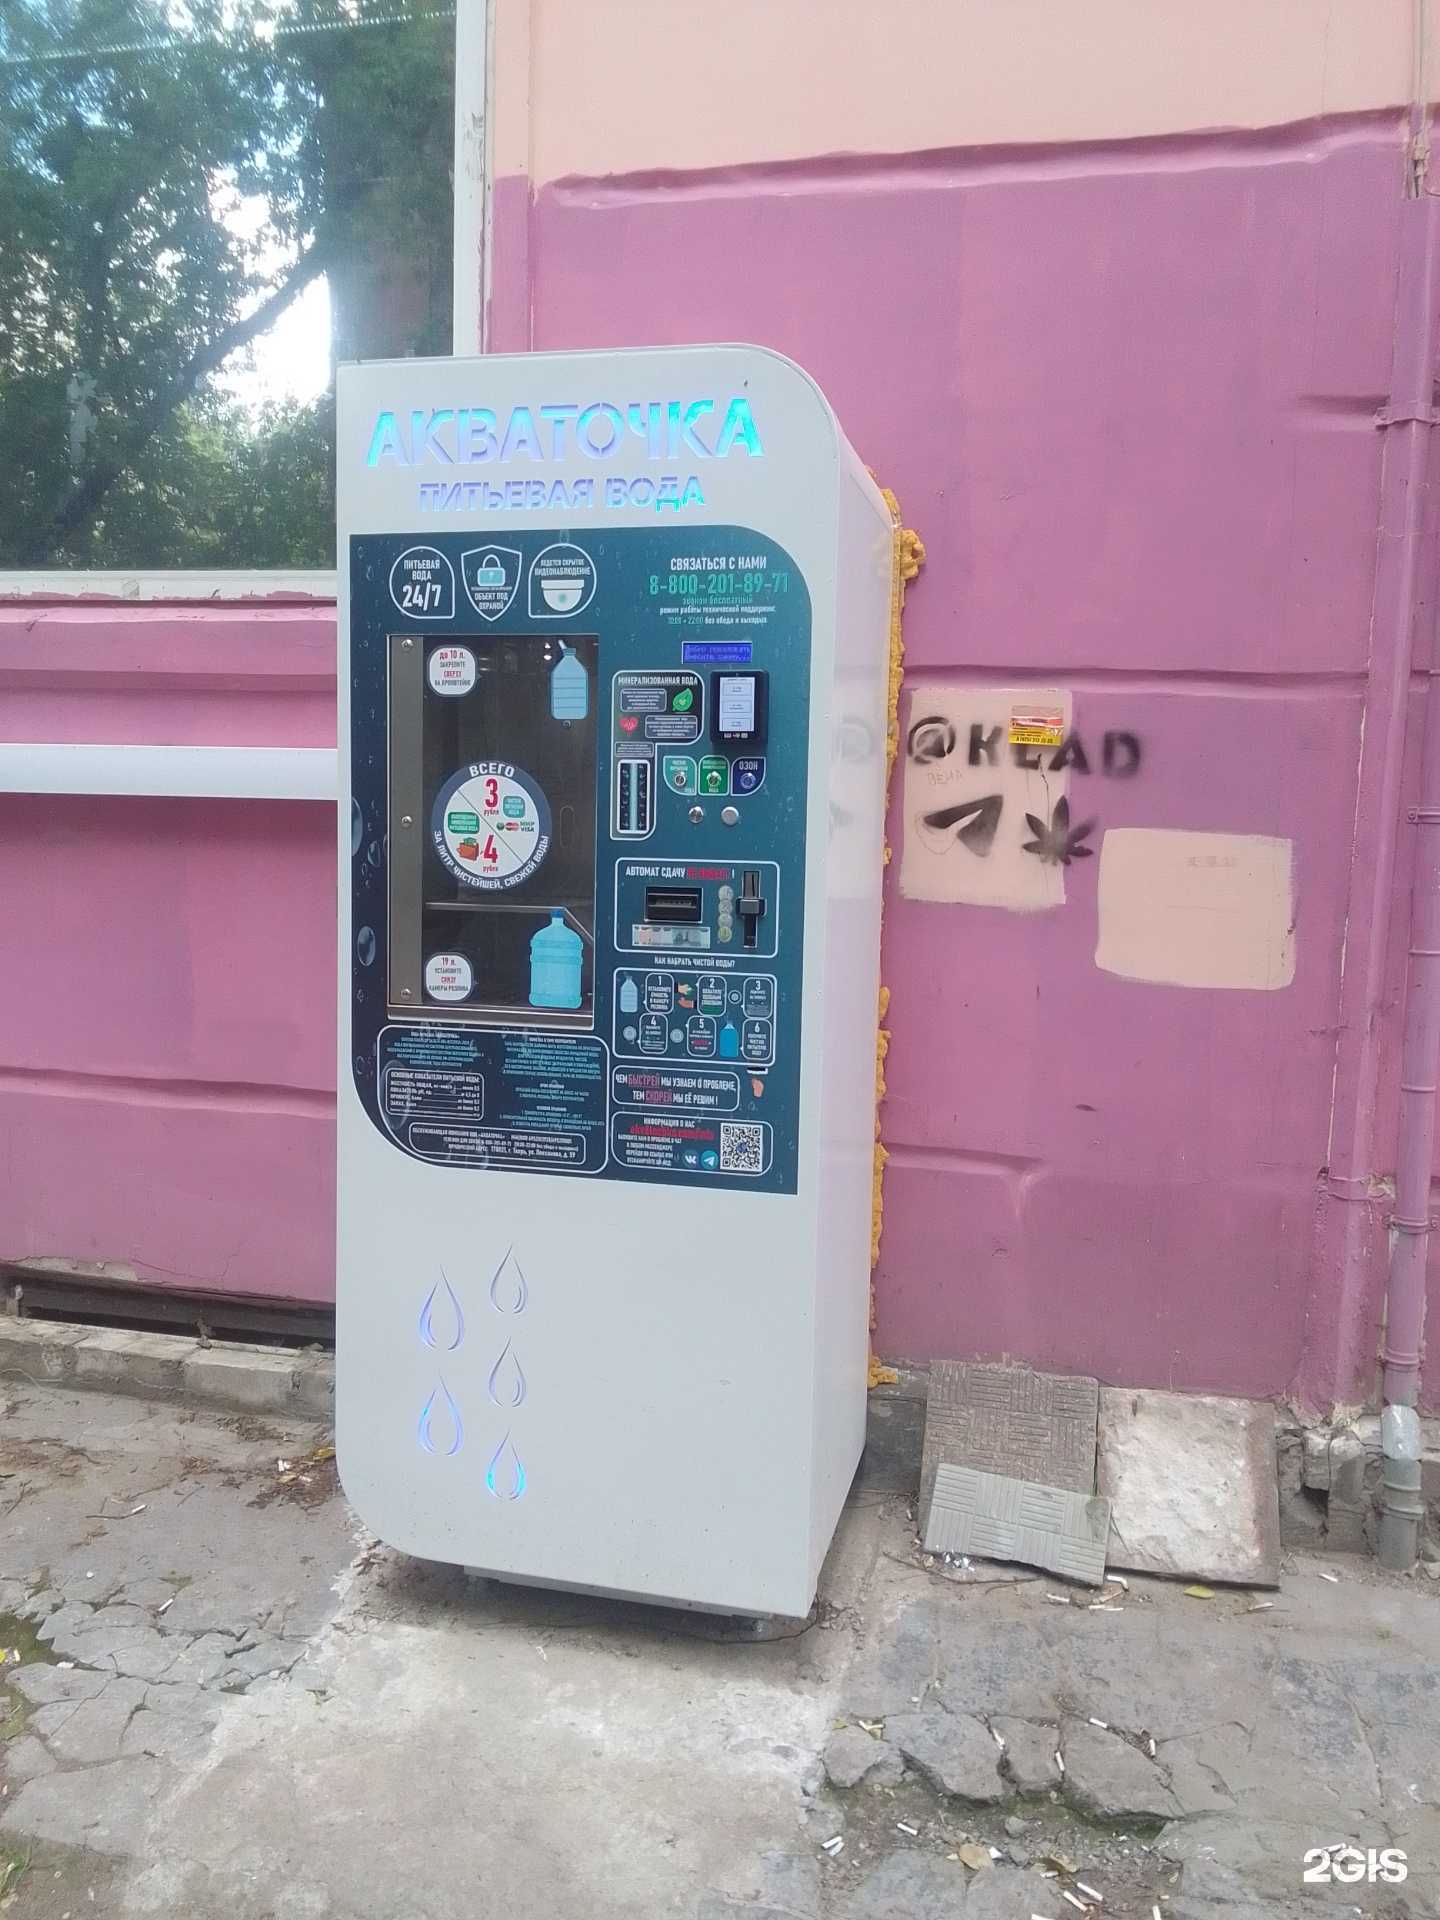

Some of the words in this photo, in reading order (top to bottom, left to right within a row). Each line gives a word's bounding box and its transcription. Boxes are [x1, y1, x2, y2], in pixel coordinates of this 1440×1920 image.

[367, 398, 765, 467] АКВАТОЧКА
[420, 478, 594, 513] ПИТЬЕВАЯ
[605, 475, 706, 513] ВОДА
[404, 559, 440, 570] ПИТЬЕВАЯ
[670, 557, 726, 571] СВЯЗАТЬСЯ
[729, 557, 735, 570] С
[738, 556, 767, 569] НАМИ
[411, 571, 432, 581] ВОДА
[534, 566, 591, 576] ВИДЕОНАБЛЮДЕНИЕ
[649, 572, 791, 595] 8-800-201-89-71
[402, 583, 442, 611] 24/7
[474, 592, 496, 601] ОБЪЕКТ
[497, 592, 508, 601] ПОД
[478, 600, 504, 610] ОХРАНОЙ
[450, 650, 458, 659] 10
[618, 676, 681, 685] МИНЕРАЛИЗОВАННАЯ
[681, 676, 698, 685] ВОДА
[469, 762, 515, 778] ВСЕГО
[739, 760, 758, 770] ОЗОН
[484, 778, 498, 808] 3
[434, 831, 443, 843] ЗА
[483, 834, 498, 864] 4
[533, 835, 550, 862] ВОДЫ
[437, 844, 454, 866] ЛИТР
[504, 862, 537, 887] СВЕЖЕЙ
[626, 866, 659, 877] АВТОМАТ
[661, 867, 686, 879] СДАЧУ
[654, 957, 666, 965] КАК
[667, 957, 692, 967] НАБРАТЬ
[693, 957, 715, 967] ЧИСТОЙ
[709, 978, 715, 988] 2
[755, 980, 761, 990] 3
[650, 1016, 656, 1026] 4
[699, 1018, 705, 1029] 5
[754, 1022, 760, 1033] 6
[616, 1074, 628, 1084] ЧЕМ
[628, 1073, 660, 1088] БЫСТРЕЙ
[661, 1076, 672, 1086] МЫ
[672, 1077, 697, 1088] УЗНАЕМ
[633, 1090, 645, 1101] ТЕМ
[673, 1093, 684, 1103] МЫ
[693, 1095, 714, 1105] РЕШИМ
[643, 1117, 679, 1128] ИНФОРМАЦИЯ
[684, 1119, 696, 1129] НАС
